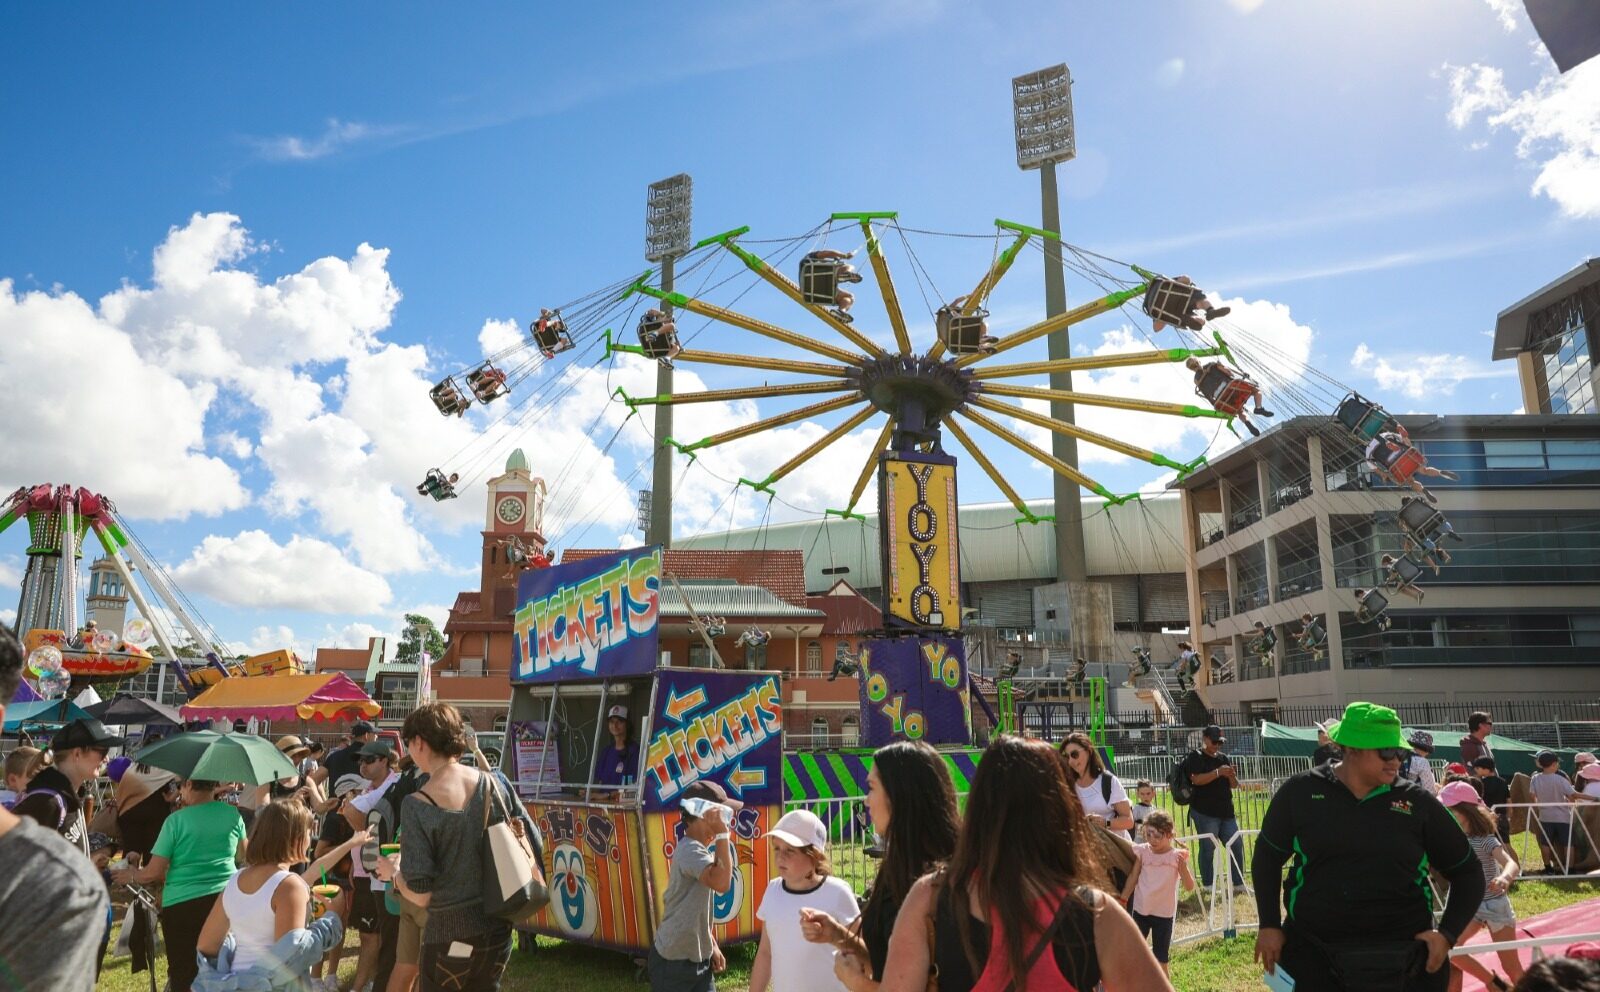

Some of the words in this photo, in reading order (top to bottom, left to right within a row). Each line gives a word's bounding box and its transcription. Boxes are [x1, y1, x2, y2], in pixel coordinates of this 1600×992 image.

[514, 550, 660, 676] TICKETS
[923, 644, 960, 688] YO
[646, 677, 783, 800] TICKETS
[882, 696, 924, 740] YO
